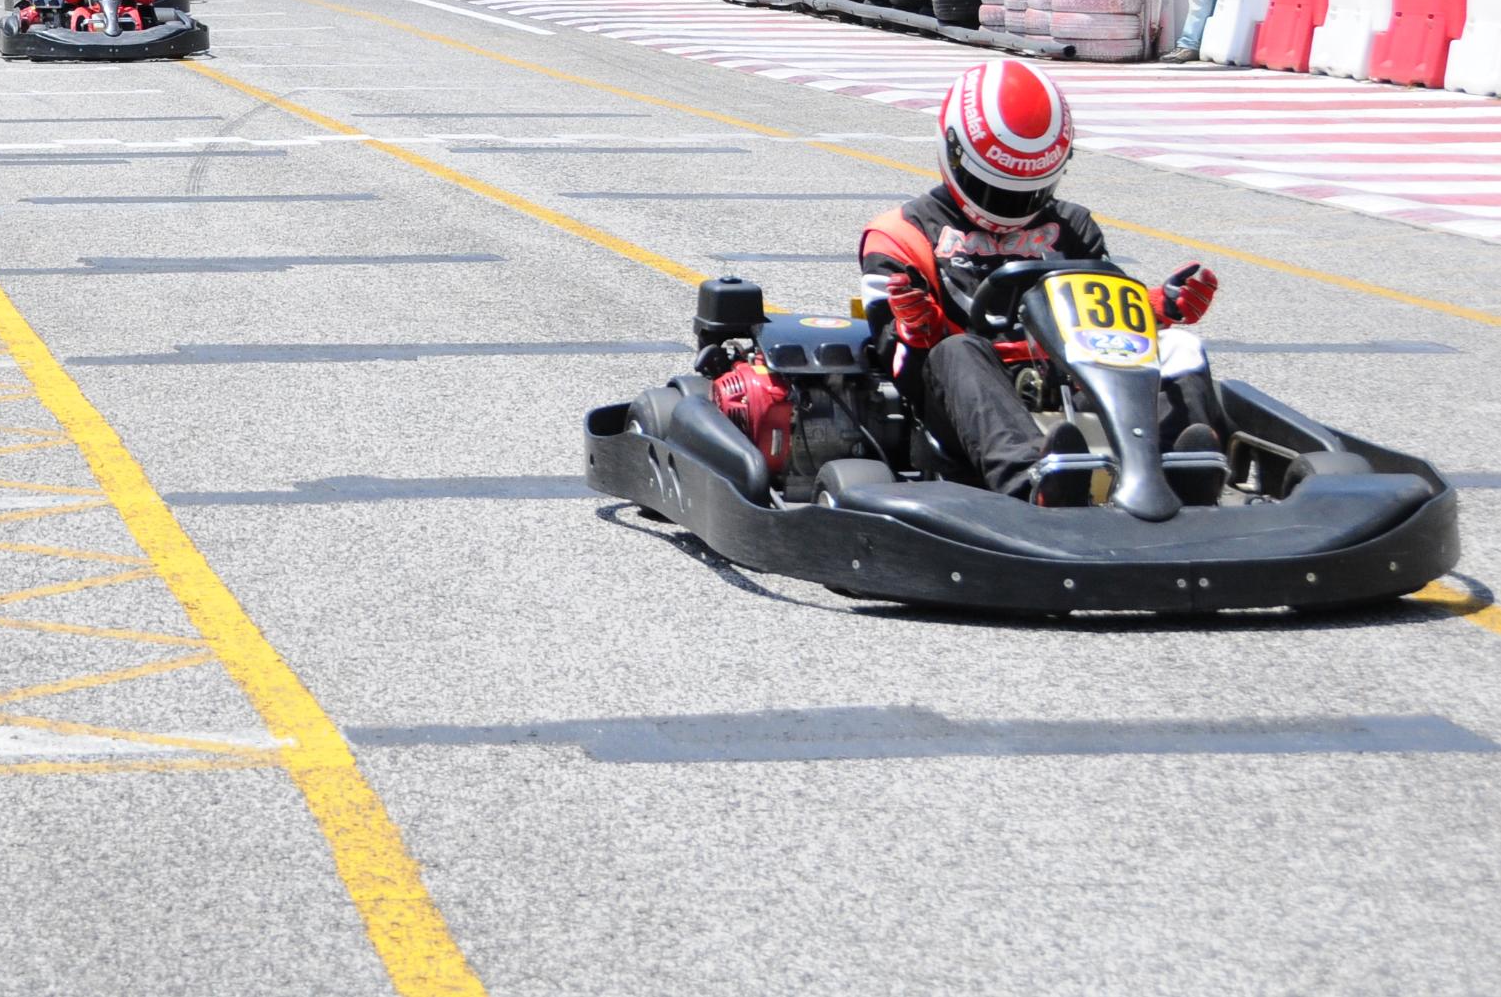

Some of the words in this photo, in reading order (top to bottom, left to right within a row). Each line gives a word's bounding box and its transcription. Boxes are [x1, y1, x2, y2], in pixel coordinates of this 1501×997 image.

[963, 67, 988, 143] parmalat
[986, 144, 1064, 172] parmalat
[1057, 281, 1147, 334] 136
